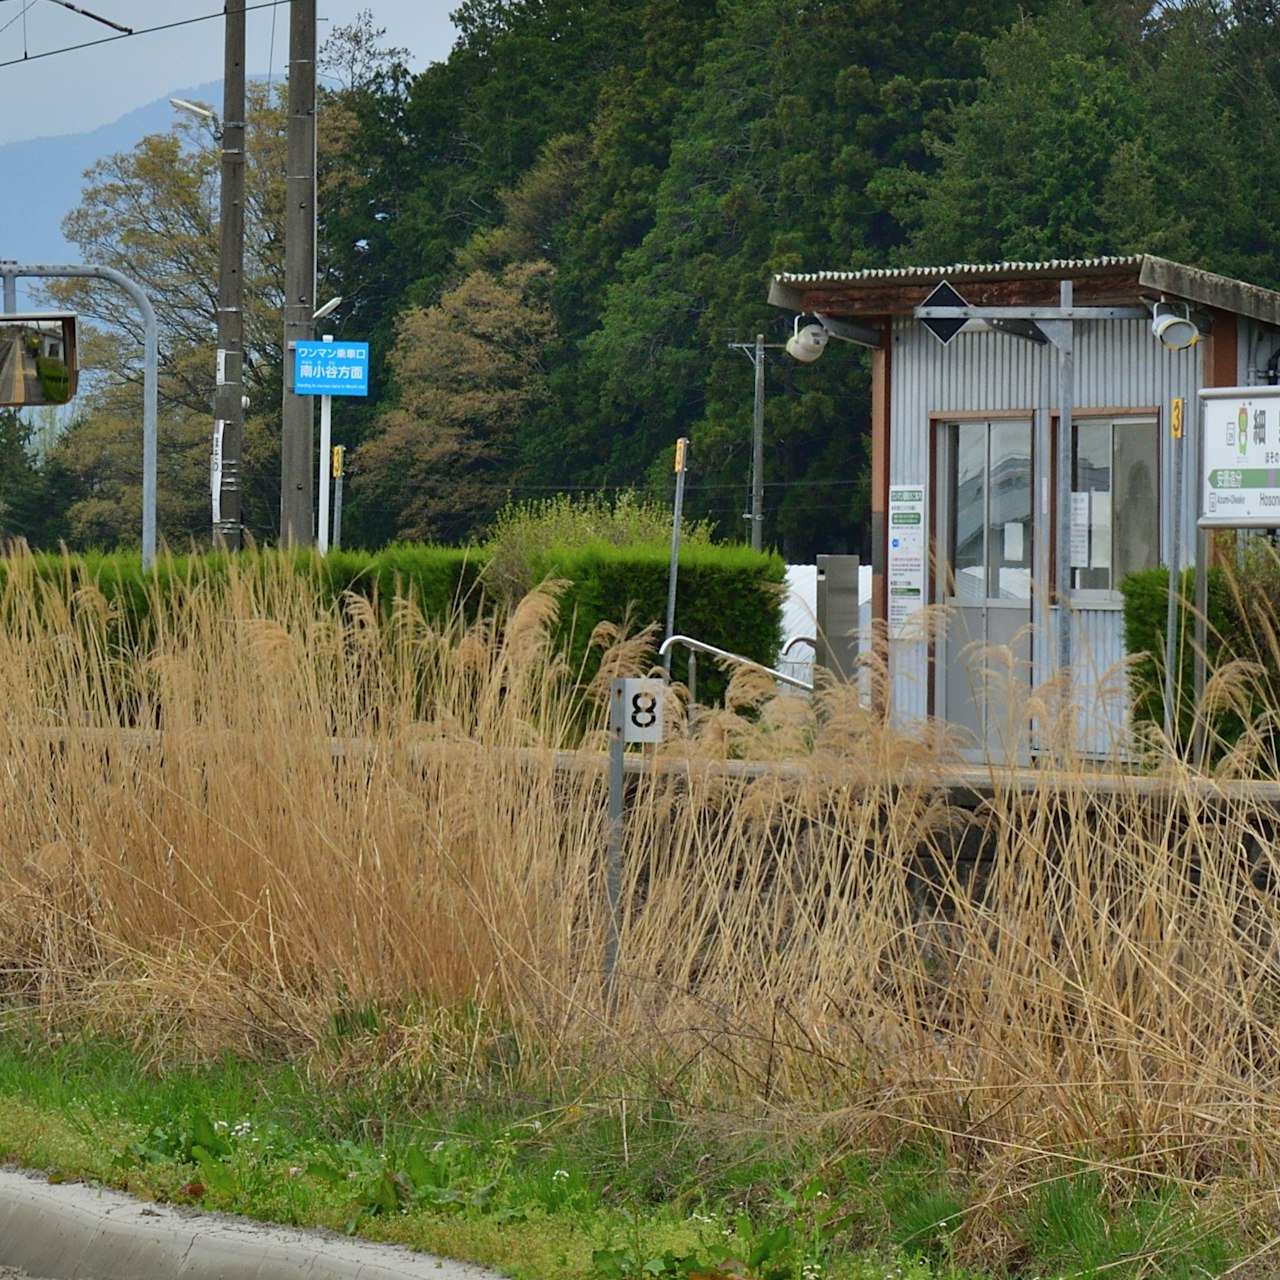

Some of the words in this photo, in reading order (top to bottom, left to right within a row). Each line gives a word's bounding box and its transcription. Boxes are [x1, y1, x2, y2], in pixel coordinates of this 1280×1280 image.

[298, 348, 366, 359] ワンマン乗車口
[300, 365, 363, 379] 南小谷方面
[631, 692, 657, 728] 8
